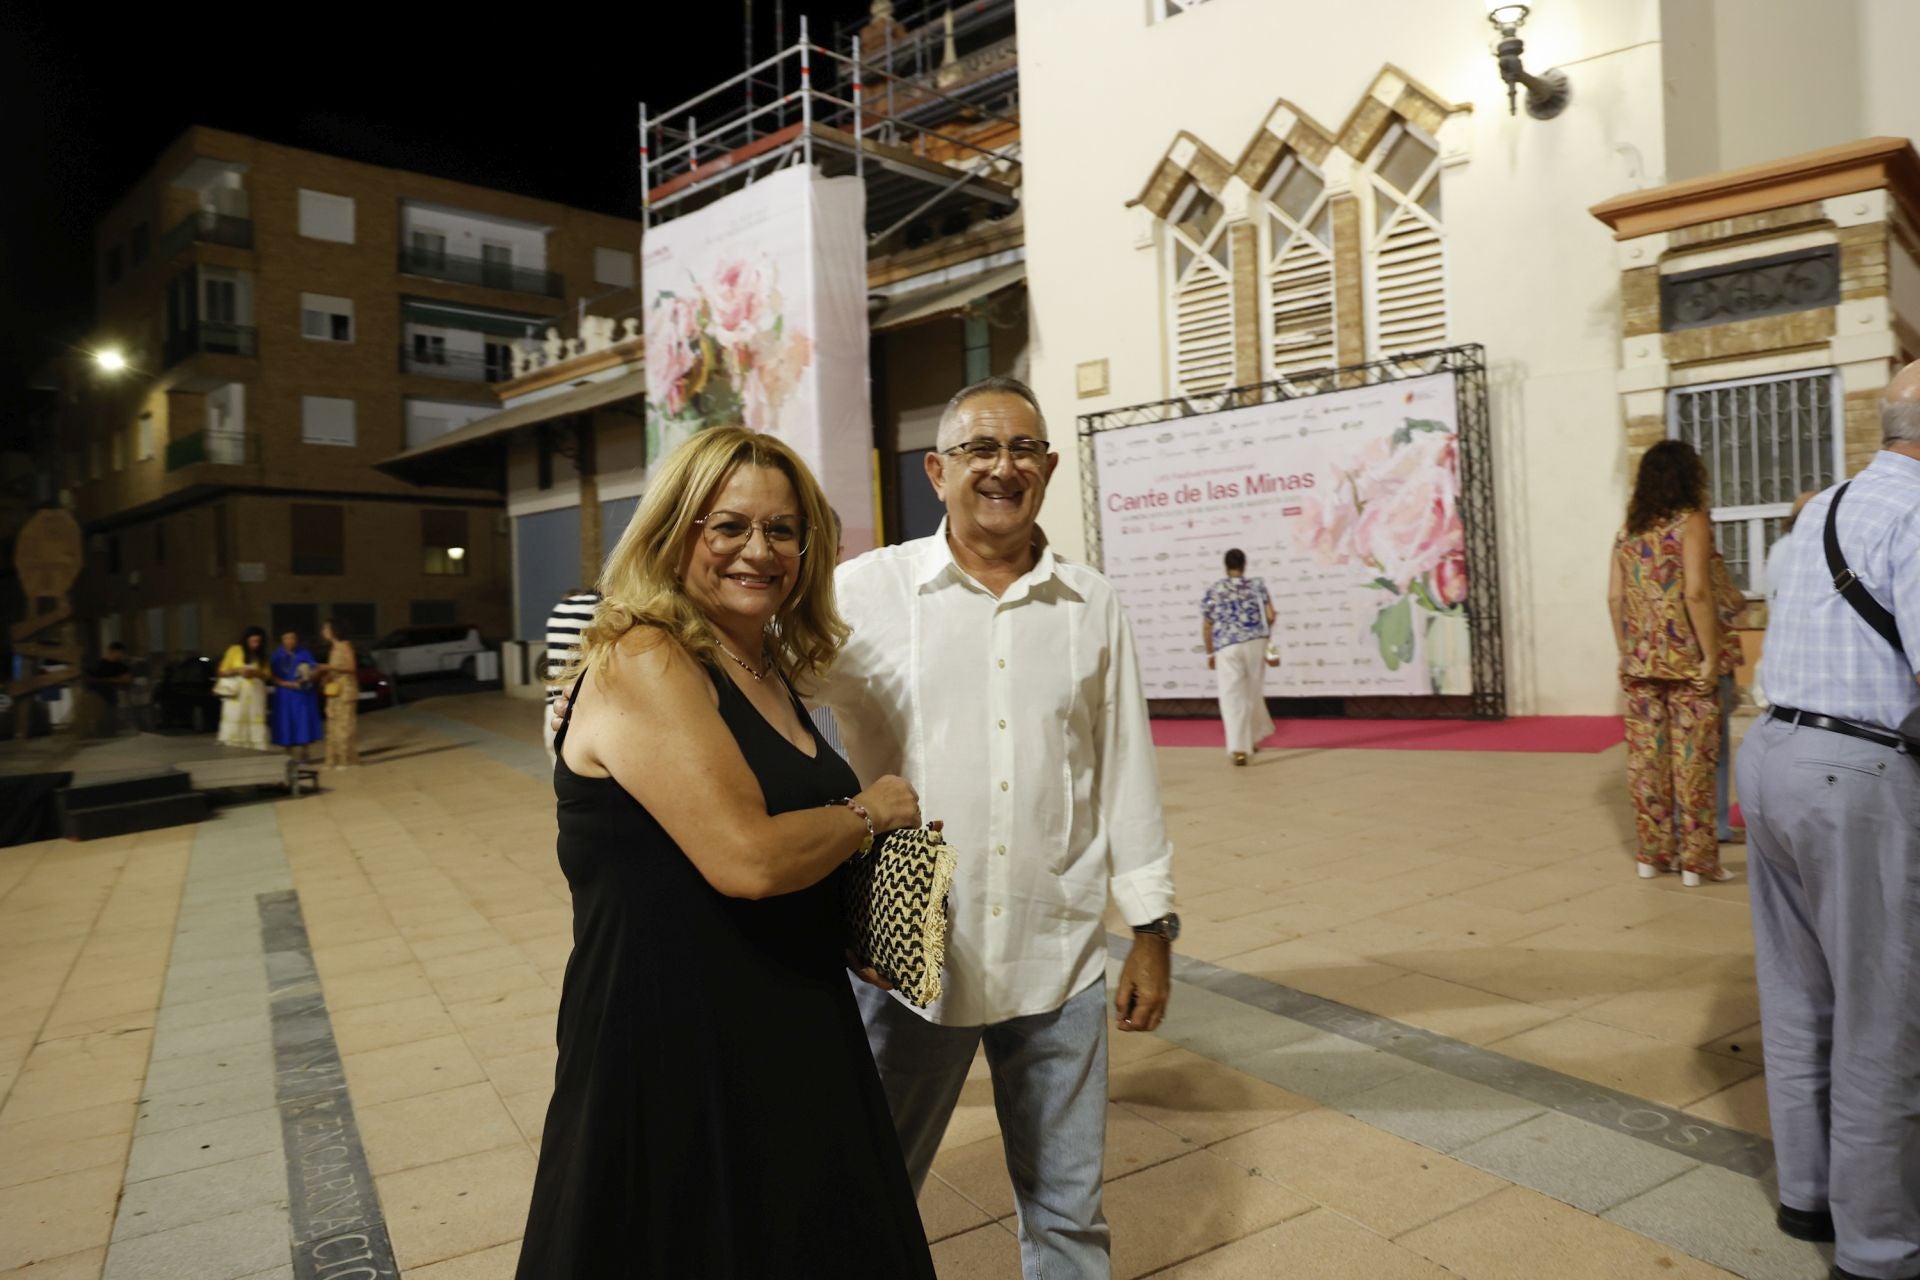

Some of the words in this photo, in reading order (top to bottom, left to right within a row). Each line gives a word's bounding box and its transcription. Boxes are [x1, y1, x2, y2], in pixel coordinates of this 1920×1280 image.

[1107, 487, 1169, 513] Cante
[1174, 483, 1201, 504] de
[1207, 479, 1240, 501] las
[1245, 471, 1316, 496] Minas
